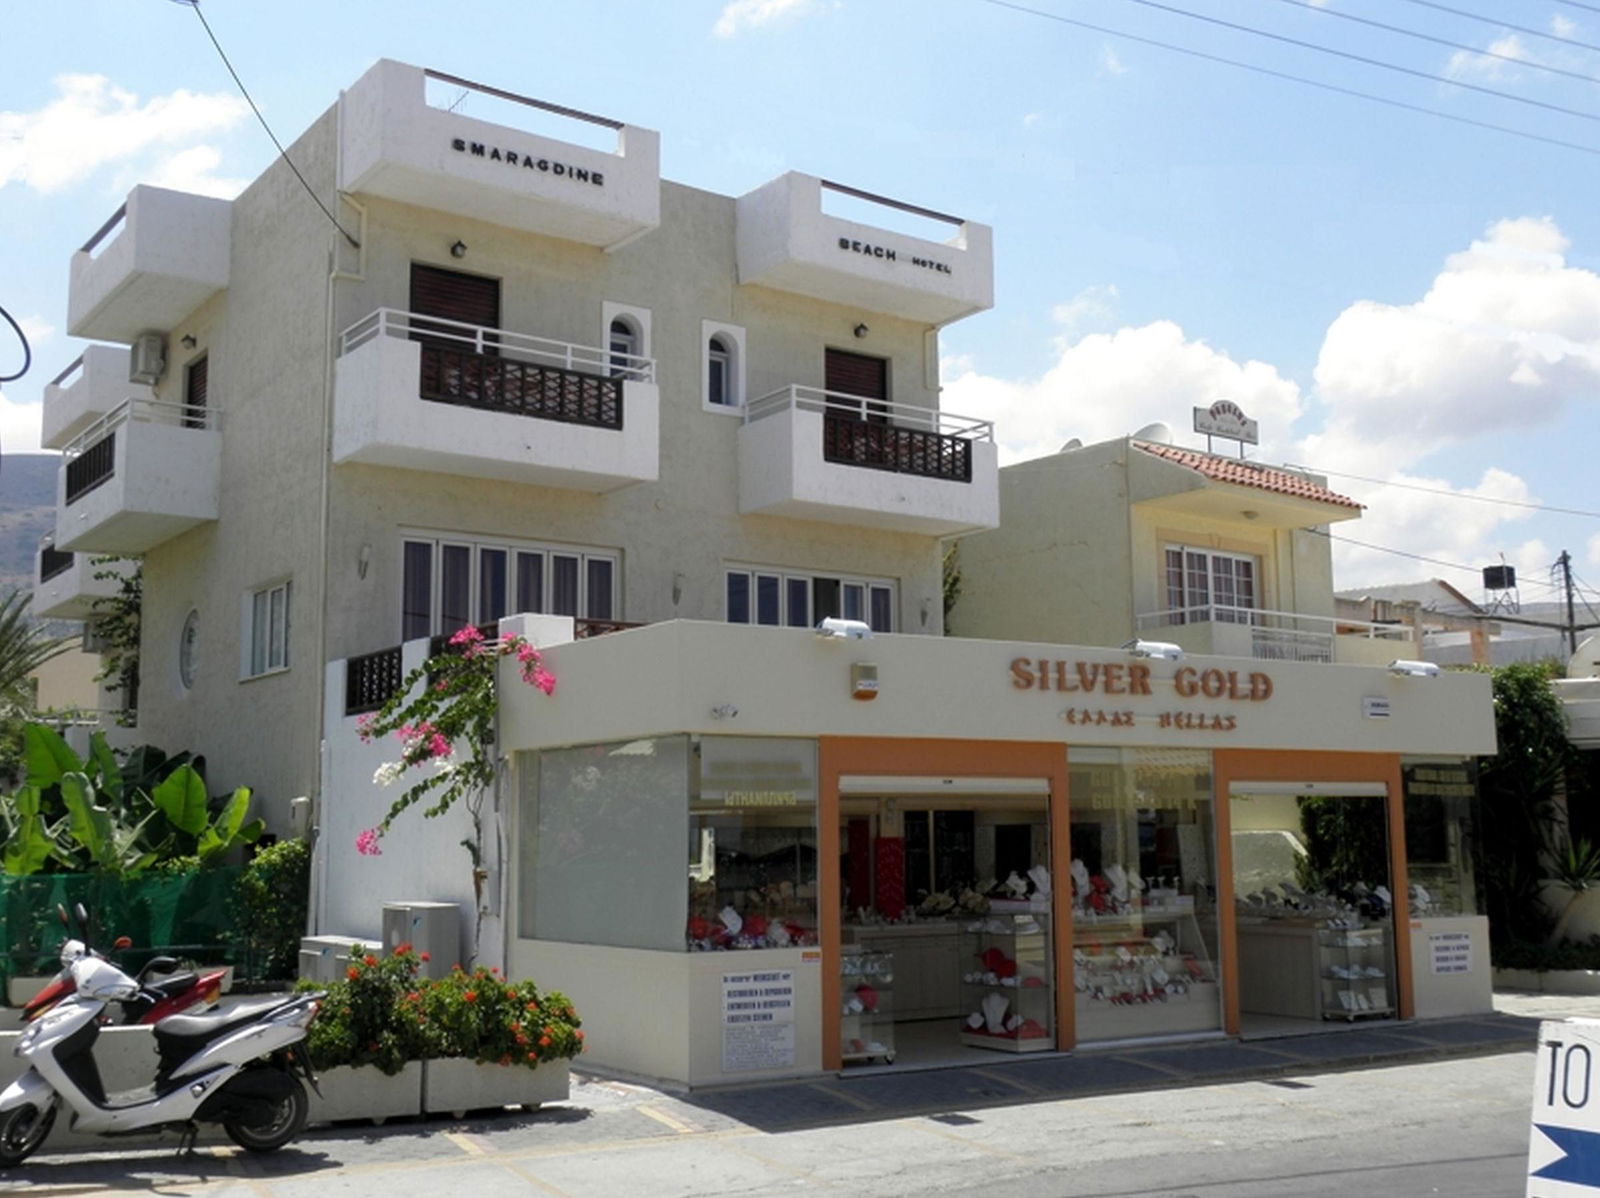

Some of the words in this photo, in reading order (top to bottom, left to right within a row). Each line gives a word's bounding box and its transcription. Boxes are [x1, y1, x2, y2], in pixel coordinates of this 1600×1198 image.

[452, 138, 604, 186] SMARAGDINE
[838, 237, 896, 261] BEACH
[911, 256, 952, 274] HOTEL
[1010, 656, 1152, 696] SILVER
[1174, 665, 1274, 701] GOLD
[1158, 711, 1237, 731] HELLAS
[1545, 1040, 1591, 1109] TO
